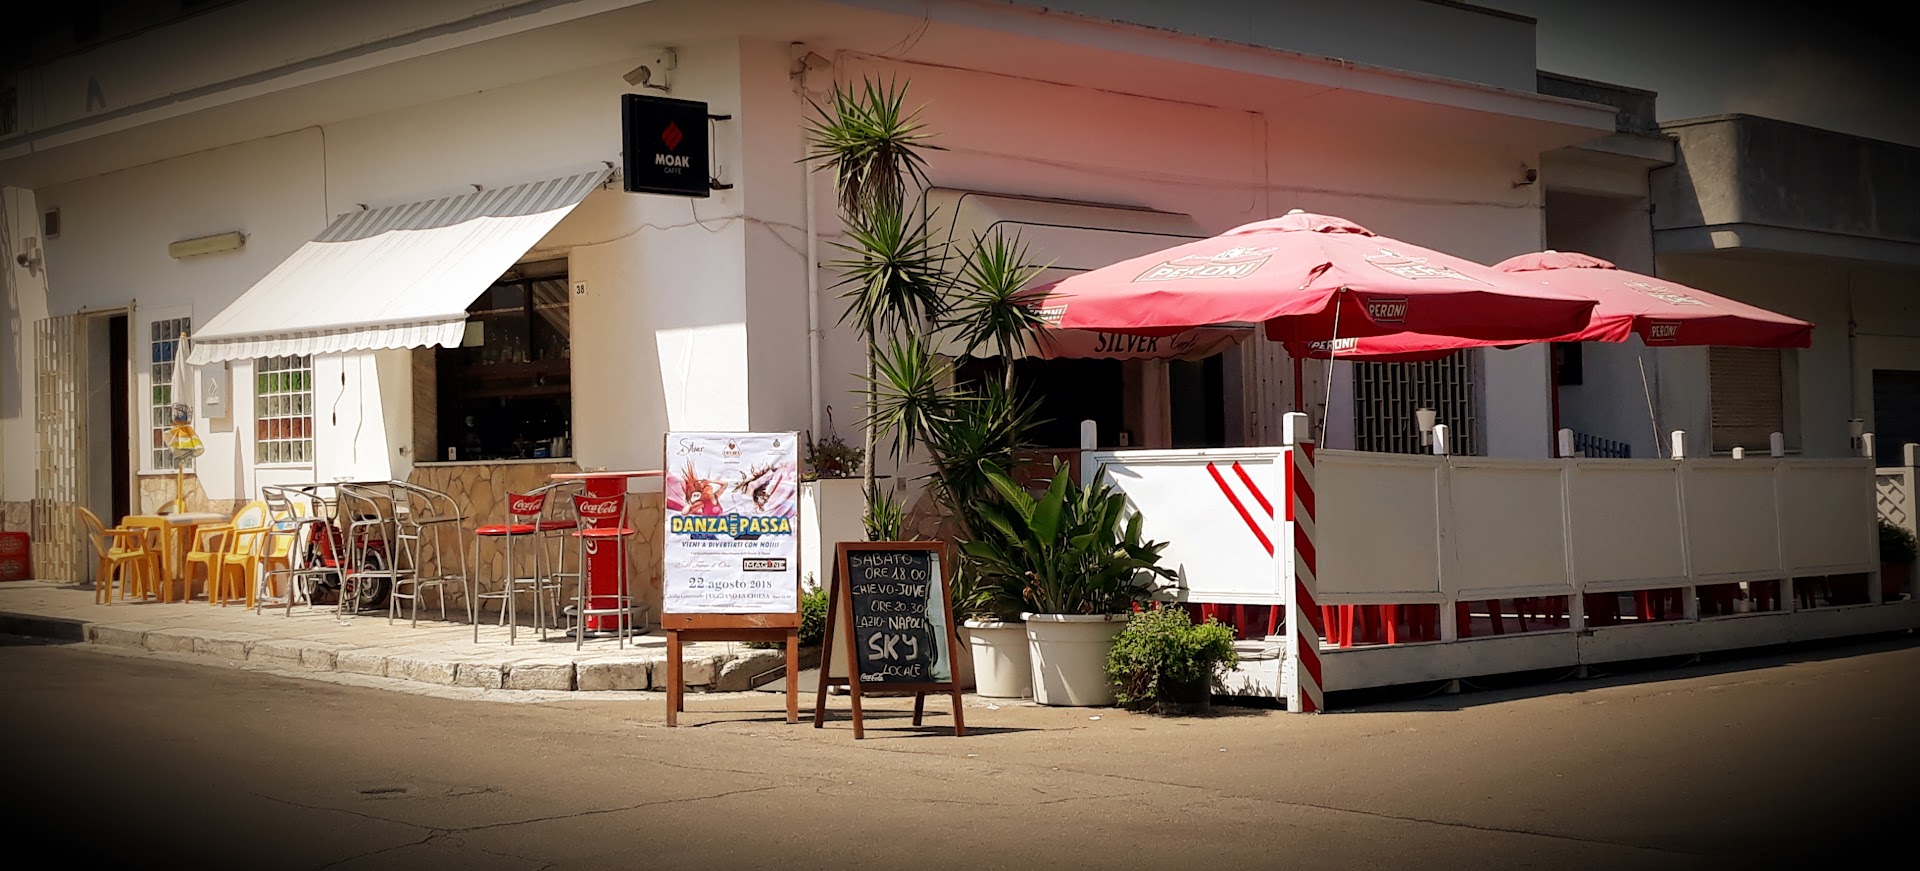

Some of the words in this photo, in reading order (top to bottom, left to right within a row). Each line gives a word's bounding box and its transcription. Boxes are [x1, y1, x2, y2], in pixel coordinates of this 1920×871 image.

[655, 153, 689, 168] MOAK
[1147, 262, 1254, 279] PERONI
[576, 284, 585, 295] 38
[1369, 304, 1406, 317] PERONI
[1652, 325, 1678, 337] PERONI
[1095, 332, 1158, 353] SILVER
[1311, 338, 1355, 350] PERONI
[580, 500, 618, 513] Coca-Cola
[672, 517, 729, 533] DANZA
[739, 517, 791, 533] PASSA
[865, 567, 889, 580] ORE
[688, 577, 705, 589] 22
[708, 579, 747, 591] agosto
[750, 580, 772, 589] 2018
[871, 600, 893, 613] ORE
[868, 631, 919, 661] SKY
